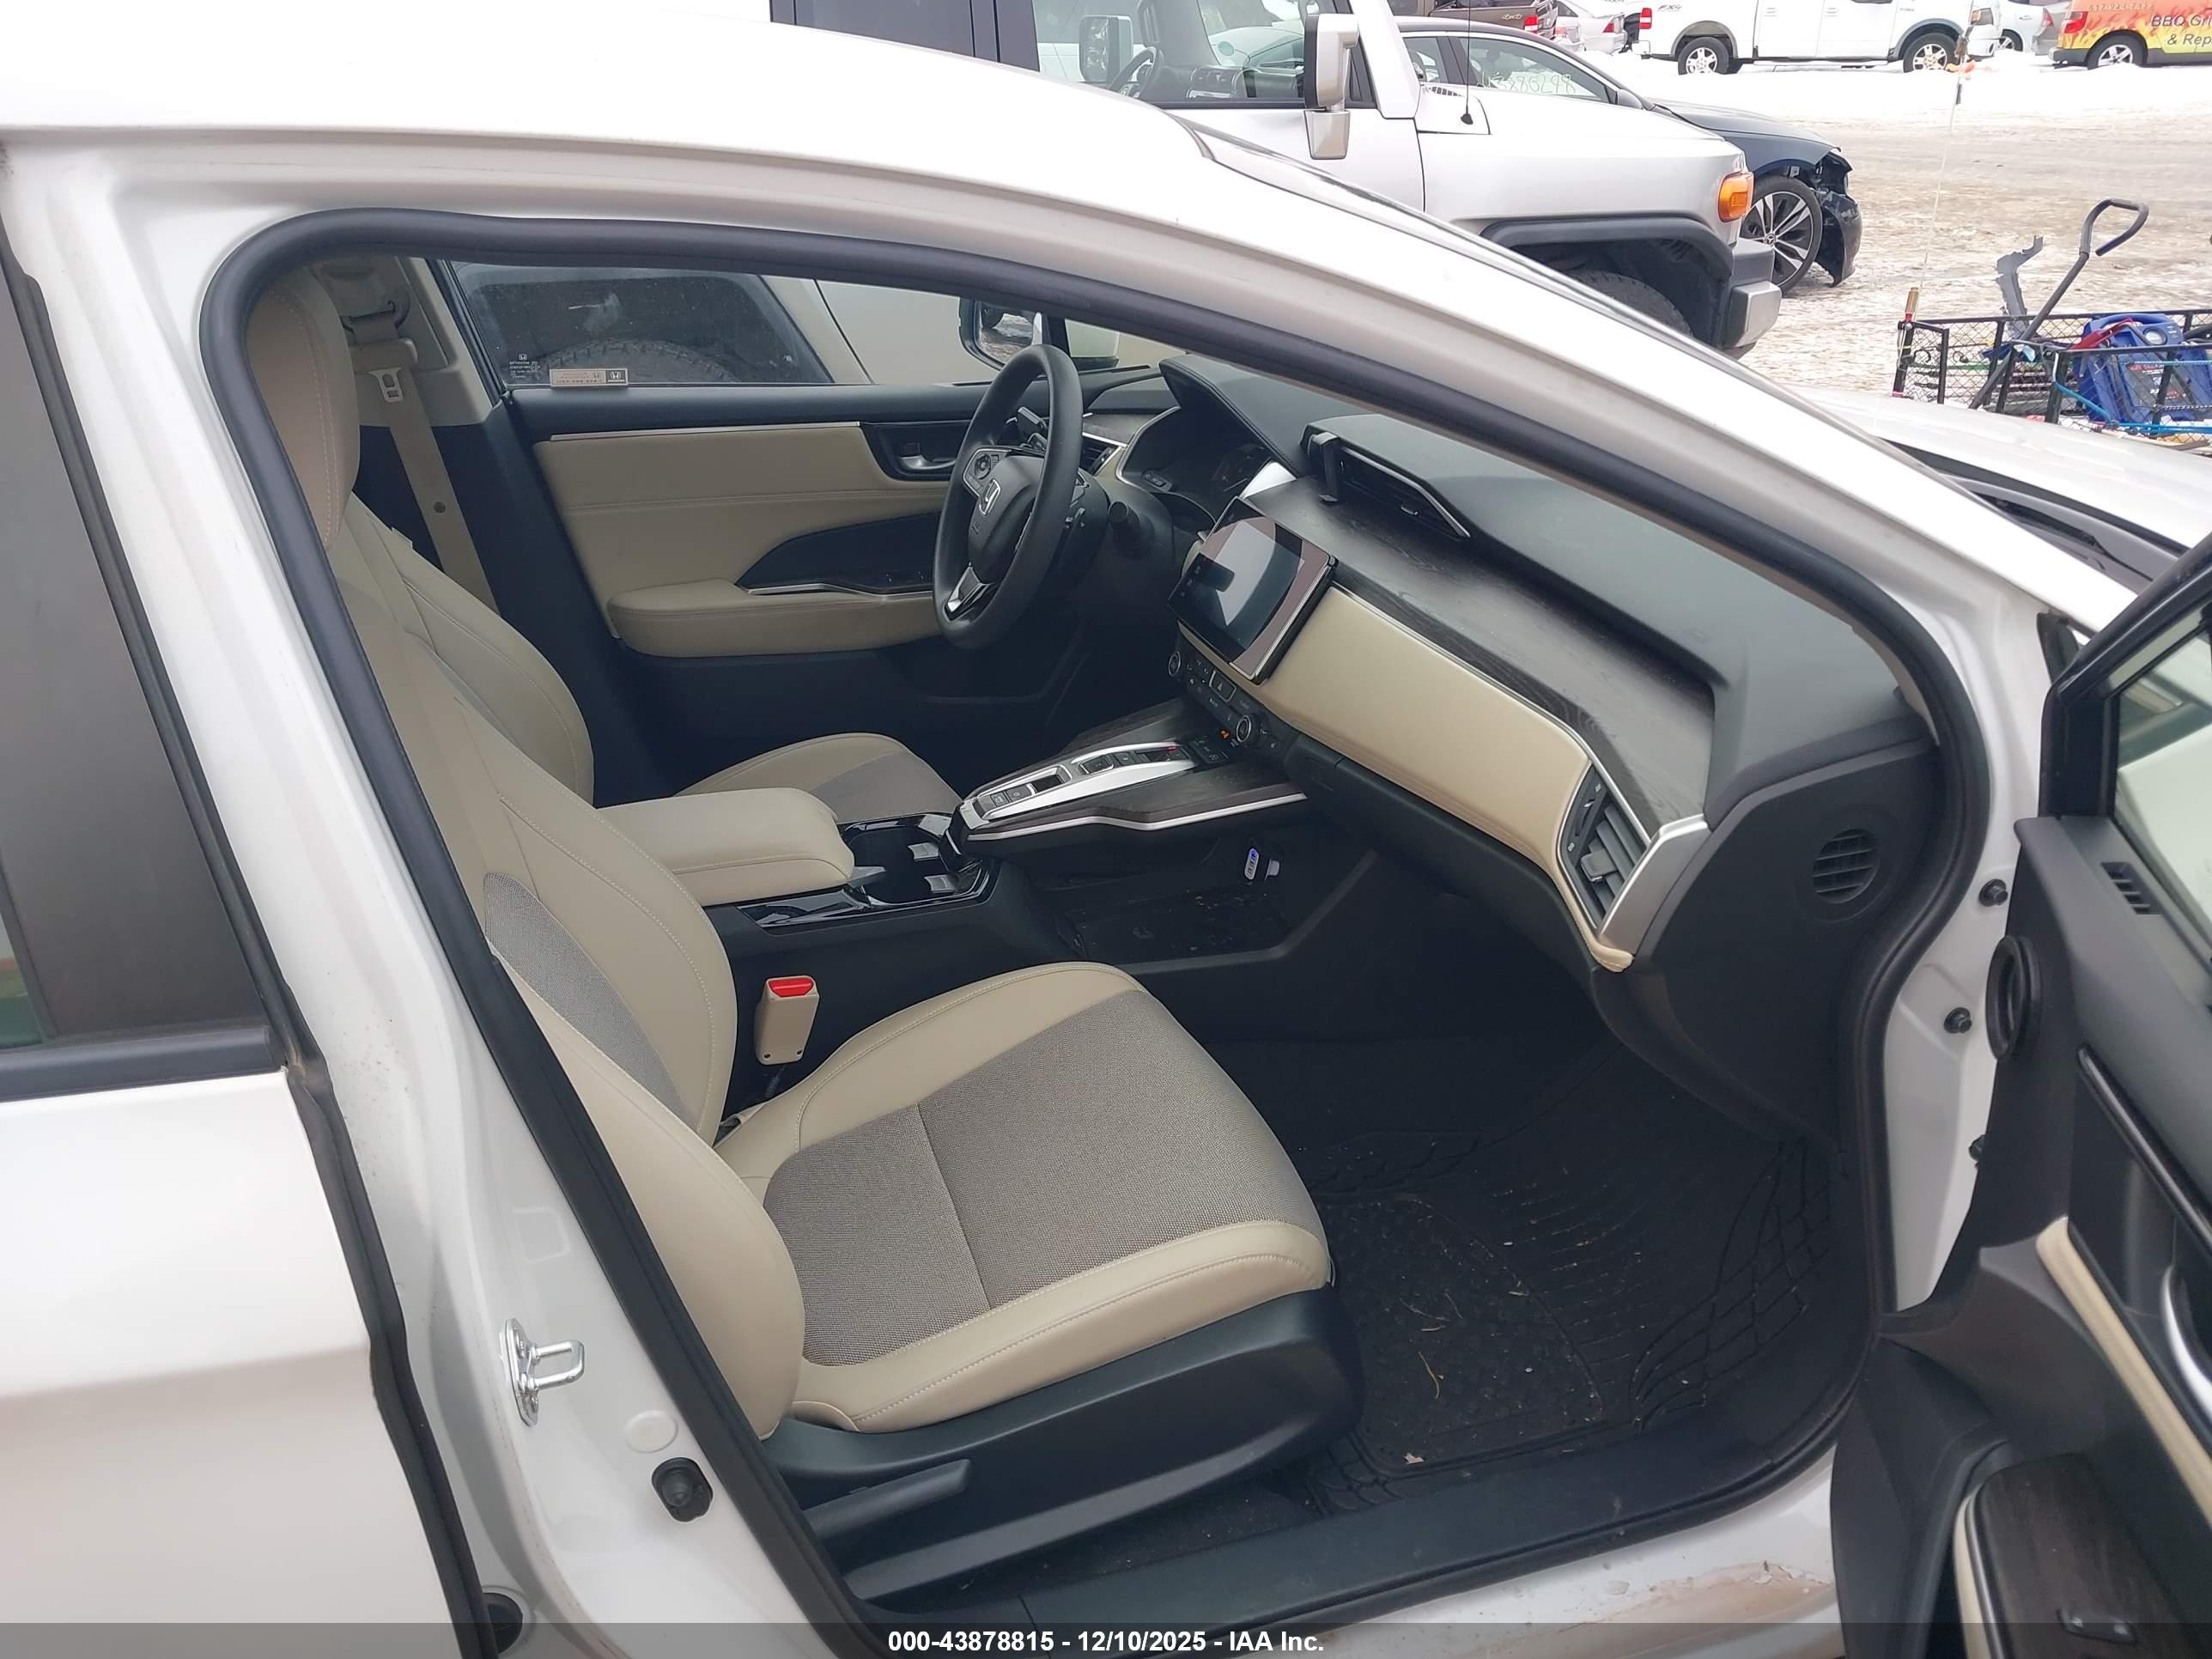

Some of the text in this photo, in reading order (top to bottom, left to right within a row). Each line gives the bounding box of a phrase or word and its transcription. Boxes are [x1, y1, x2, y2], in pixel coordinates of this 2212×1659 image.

[2151, 15, 2185, 27] BBQ
[2166, 33, 2212, 47] & Rep
